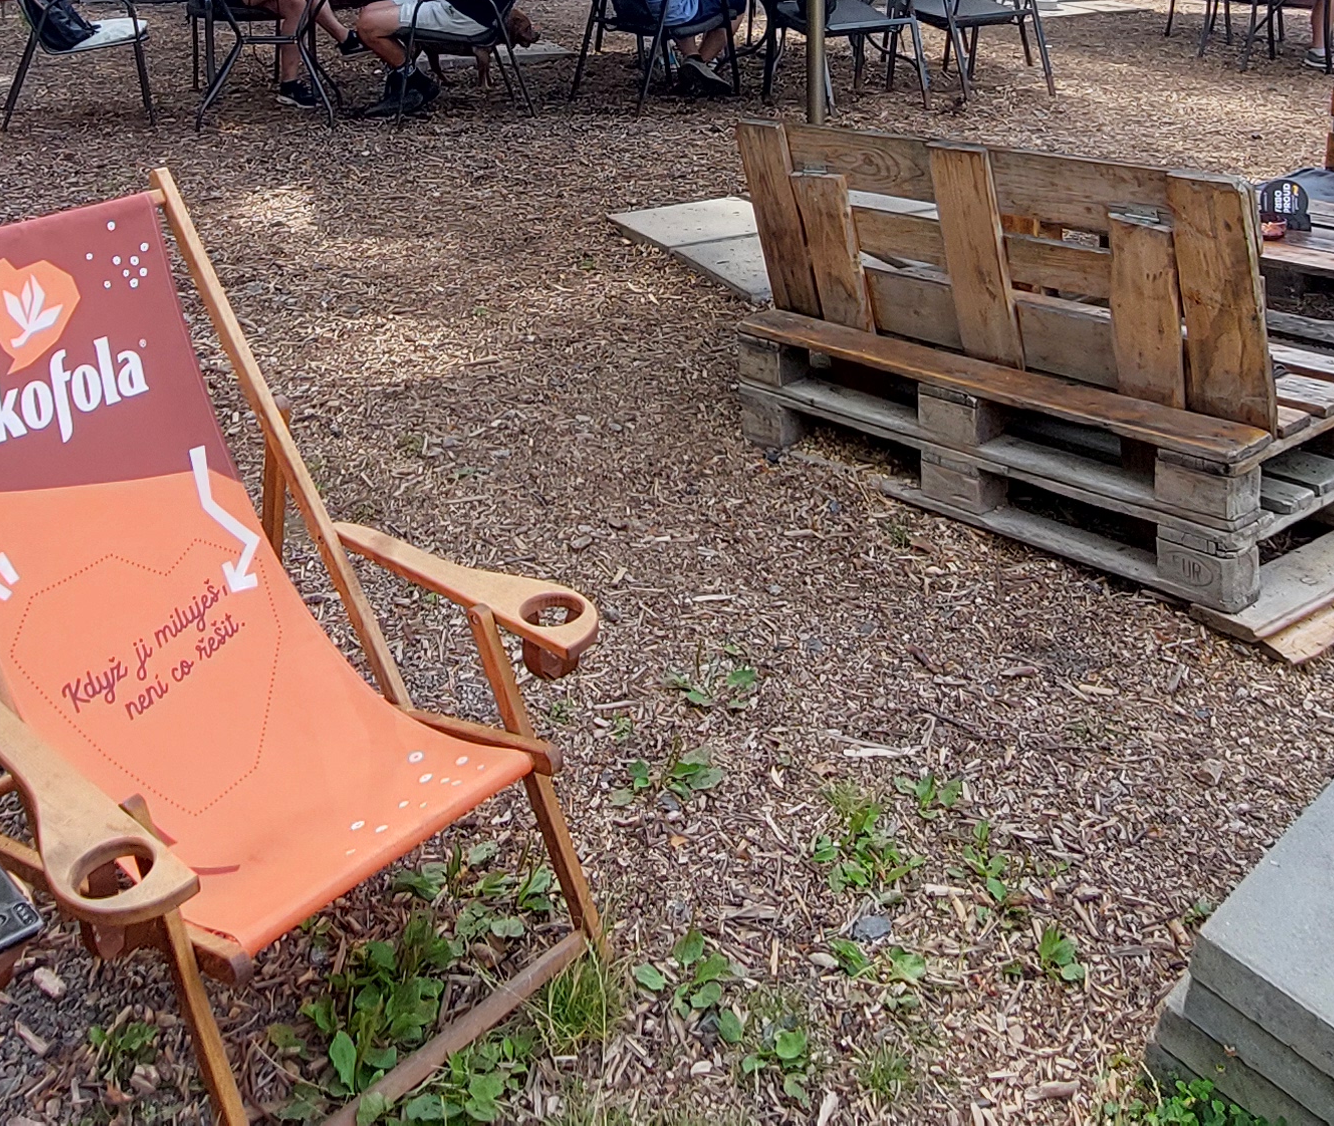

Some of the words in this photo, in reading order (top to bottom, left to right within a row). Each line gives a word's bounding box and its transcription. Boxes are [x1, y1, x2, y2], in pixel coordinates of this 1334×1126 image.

[61, 656, 128, 714] Když
[154, 578, 229, 649] miluješ,
[124, 673, 169, 721] není
[171, 659, 195, 683] co
[195, 612, 246, 661] řešit.
